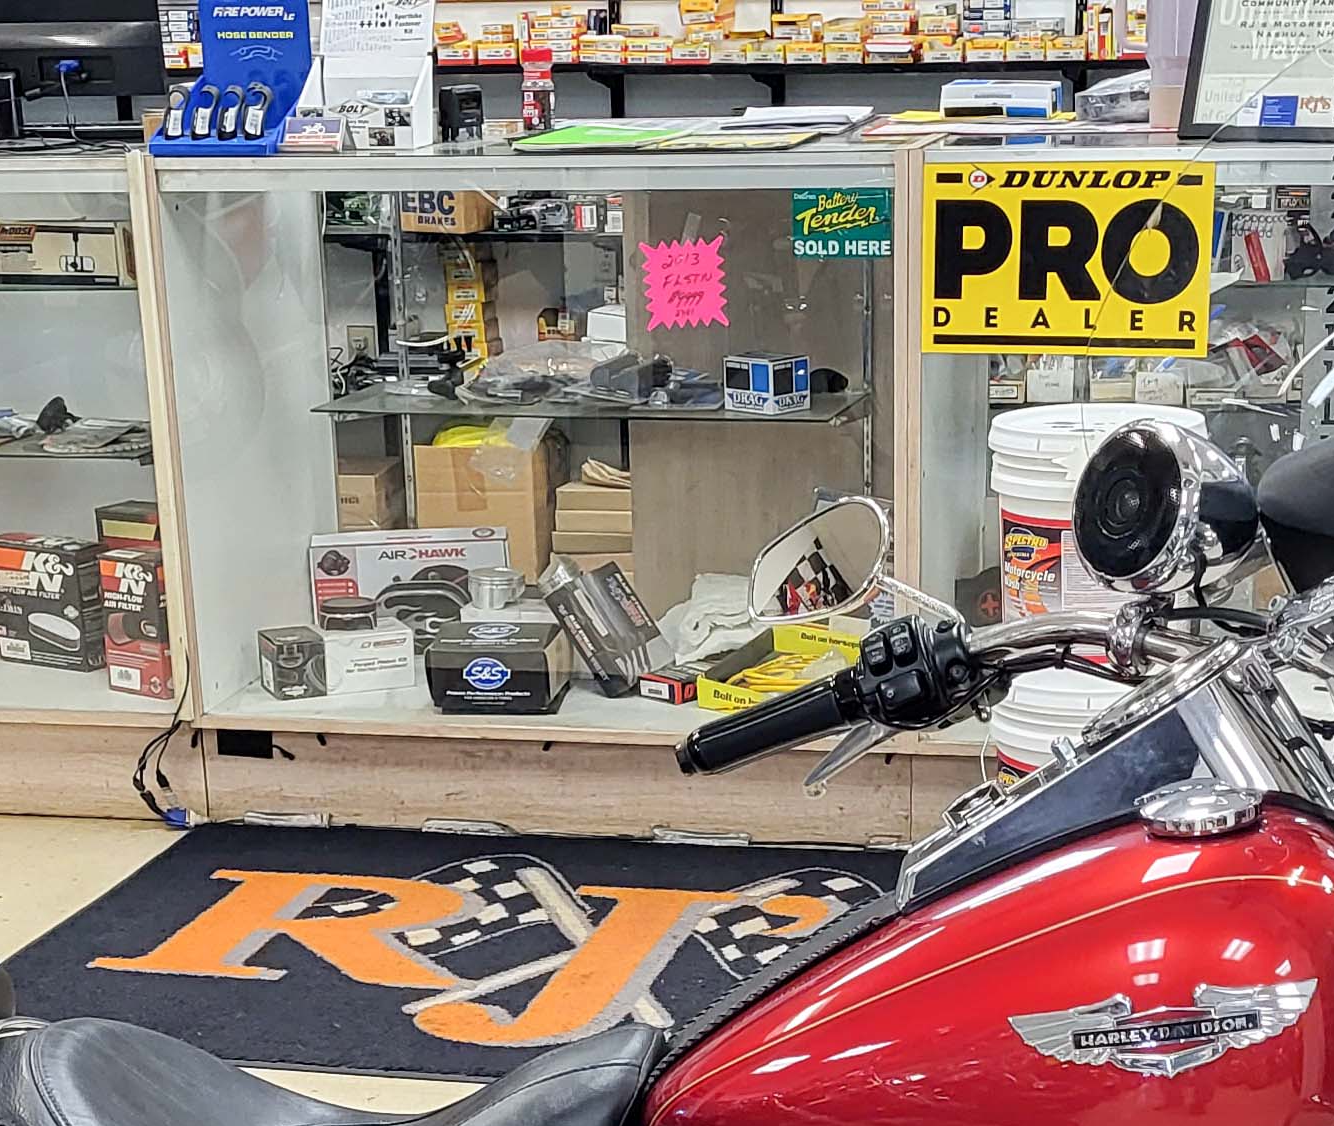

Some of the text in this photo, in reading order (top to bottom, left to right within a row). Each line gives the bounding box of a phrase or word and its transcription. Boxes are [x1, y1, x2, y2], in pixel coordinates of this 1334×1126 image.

[212, 6, 284, 18] FIRE POWER
[1317, 29, 1334, 38] NH
[338, 104, 367, 114] BOLT
[999, 170, 1171, 189] DUNLOP
[401, 190, 455, 215] EBC
[818, 191, 859, 211] Battery
[417, 215, 457, 226] BRAKES
[795, 206, 876, 235] Tender
[0, 224, 34, 238] MOOSE
[793, 240, 892, 256] SOLD HERE
[933, 198, 1199, 305] PRO
[661, 253, 700, 269] 2013
[933, 307, 1196, 331] DEALER
[732, 390, 764, 407] DRAG
[1004, 533, 1049, 550] SPECTRO
[418, 547, 467, 558] HAWK
[20, 550, 75, 593] K&N
[114, 562, 154, 596] K&N
[1004, 561, 1056, 583] Motorcycle
[103, 591, 143, 604] HIGH-FLOW
[103, 600, 144, 612] AIR FILTER
[829, 637, 861, 648] horsep
[471, 665, 503, 680] S&S
[713, 689, 747, 704] Bolt on
